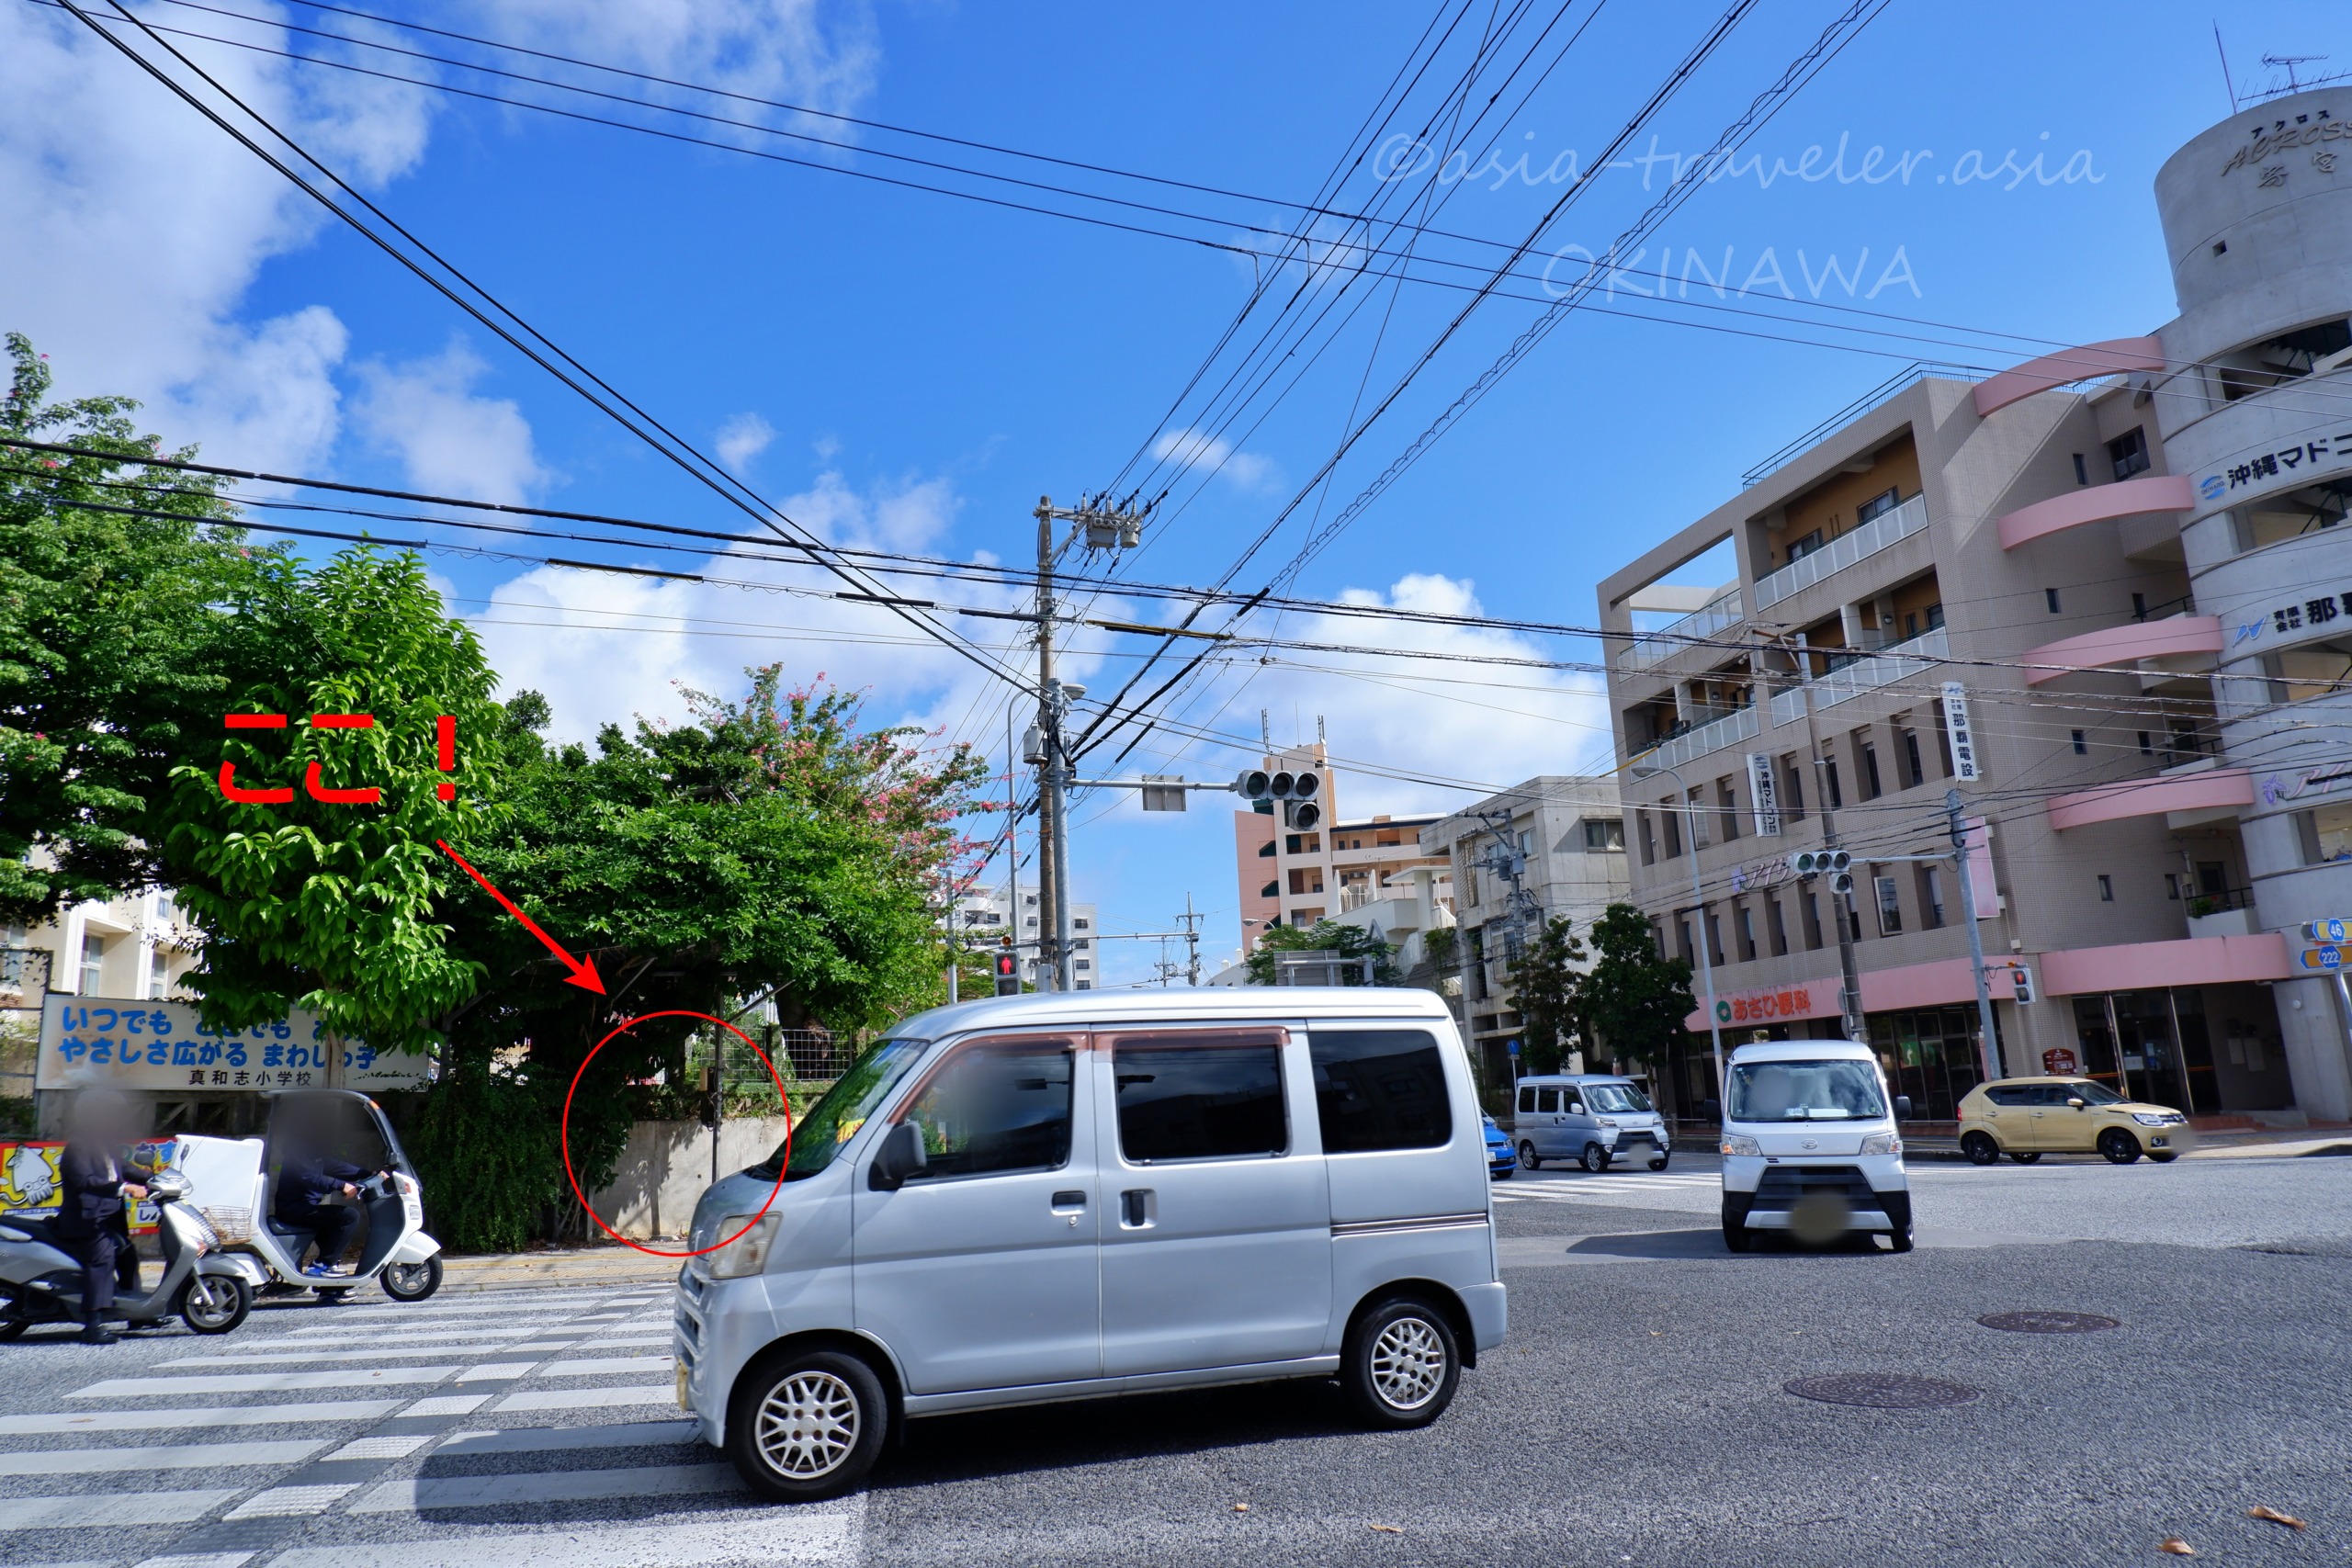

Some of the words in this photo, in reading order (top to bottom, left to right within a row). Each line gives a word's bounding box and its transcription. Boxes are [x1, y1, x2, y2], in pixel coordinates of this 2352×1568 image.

[2251, 109, 2330, 139] アクロス
[1952, 713, 1973, 777] 那覇電設
[2330, 923, 2342, 937] 46
[2322, 951, 2339, 964] 222
[1733, 988, 1811, 1021] あさひ眼科
[62, 1006, 172, 1035] いつでも
[59, 1036, 248, 1067] やさしさ広がる
[188, 1069, 311, 1087] 真和志小学校
